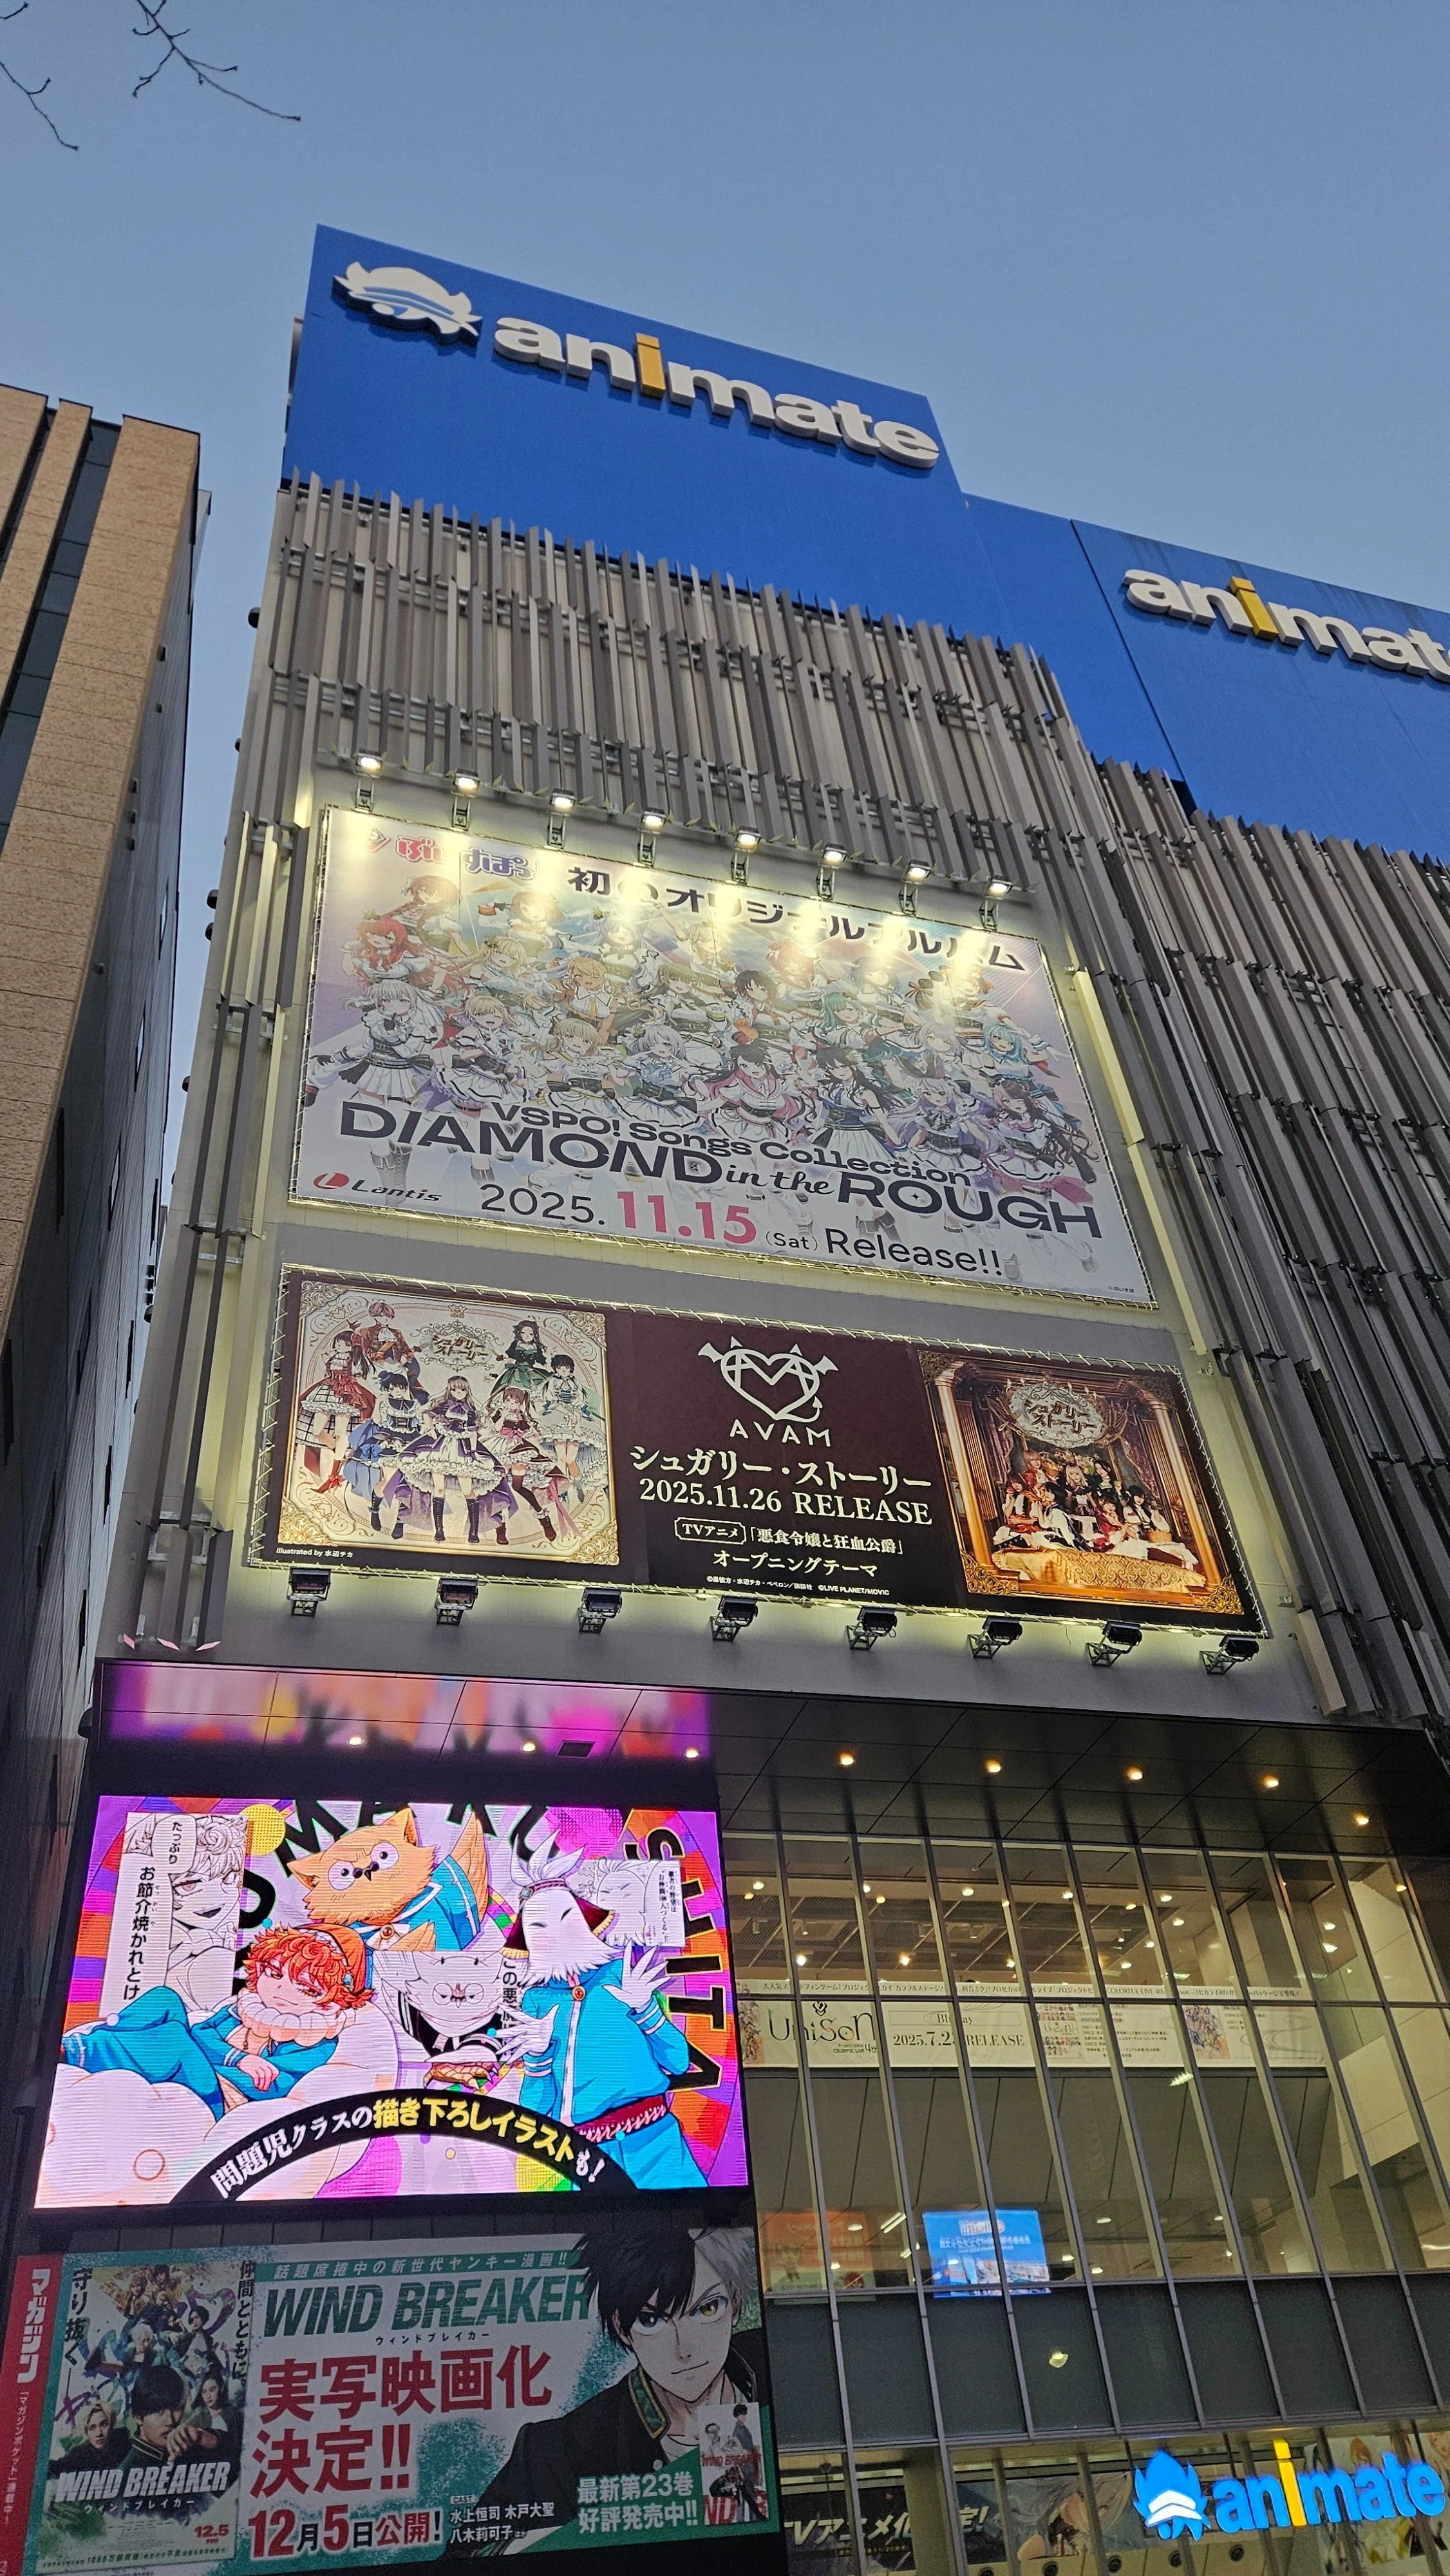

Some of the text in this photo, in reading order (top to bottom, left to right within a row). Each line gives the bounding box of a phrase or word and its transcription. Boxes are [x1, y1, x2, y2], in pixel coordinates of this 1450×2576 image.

[494, 316, 939, 468] animate
[1124, 569, 1450, 684] animat
[491, 1101, 972, 1186] VSPO! Songs Collection
[340, 1101, 1102, 1238] DIAMOND in the ROUGH
[352, 1179, 443, 1203] Lantis
[765, 1230, 819, 1252] (Sat)
[825, 1227, 1003, 1276] Release!!
[1026, 1400, 1091, 1419] シュガリー
[1030, 1414, 1097, 1435] ストーリー
[730, 1419, 831, 1447] AVAM
[629, 1445, 932, 1495] シュガリー・ストーリー
[639, 1478, 933, 1525] 2025.11.26 RELEASE
[682, 1523, 739, 1538] TVアニメ
[324, 1549, 353, 1558] 水辺チカ
[713, 1549, 878, 1578] オープニングテーマ
[123, 1866, 156, 2001] お節介焼かれとけ
[893, 2031, 1025, 2046] 2025.7.2 RELEASE
[273, 2253, 567, 2280] 話題席捲中の新世代ヤンキー漫画!!
[263, 2273, 590, 2337] WIND BREAKER
[17, 2268, 51, 2383] マガジン
[375, 2331, 491, 2345] ウィンドブレイカー
[259, 2344, 553, 2424] 実写映画化
[250, 2423, 411, 2499] 決定!!
[55, 2462, 232, 2503] WIND BREAKER
[577, 2470, 694, 2505] 最新第23巻
[1213, 2438, 1446, 2533] animate
[84, 2499, 194, 2514] ウィンドブレイカー
[450, 2501, 555, 2524] 水上恒司 木戸大聖
[578, 2499, 699, 2534] 好評発売中!!
[194, 2524, 230, 2539] 12.5
[248, 2505, 442, 2558] 12月5日公開!
[449, 2524, 514, 2544] 八木莉可子
